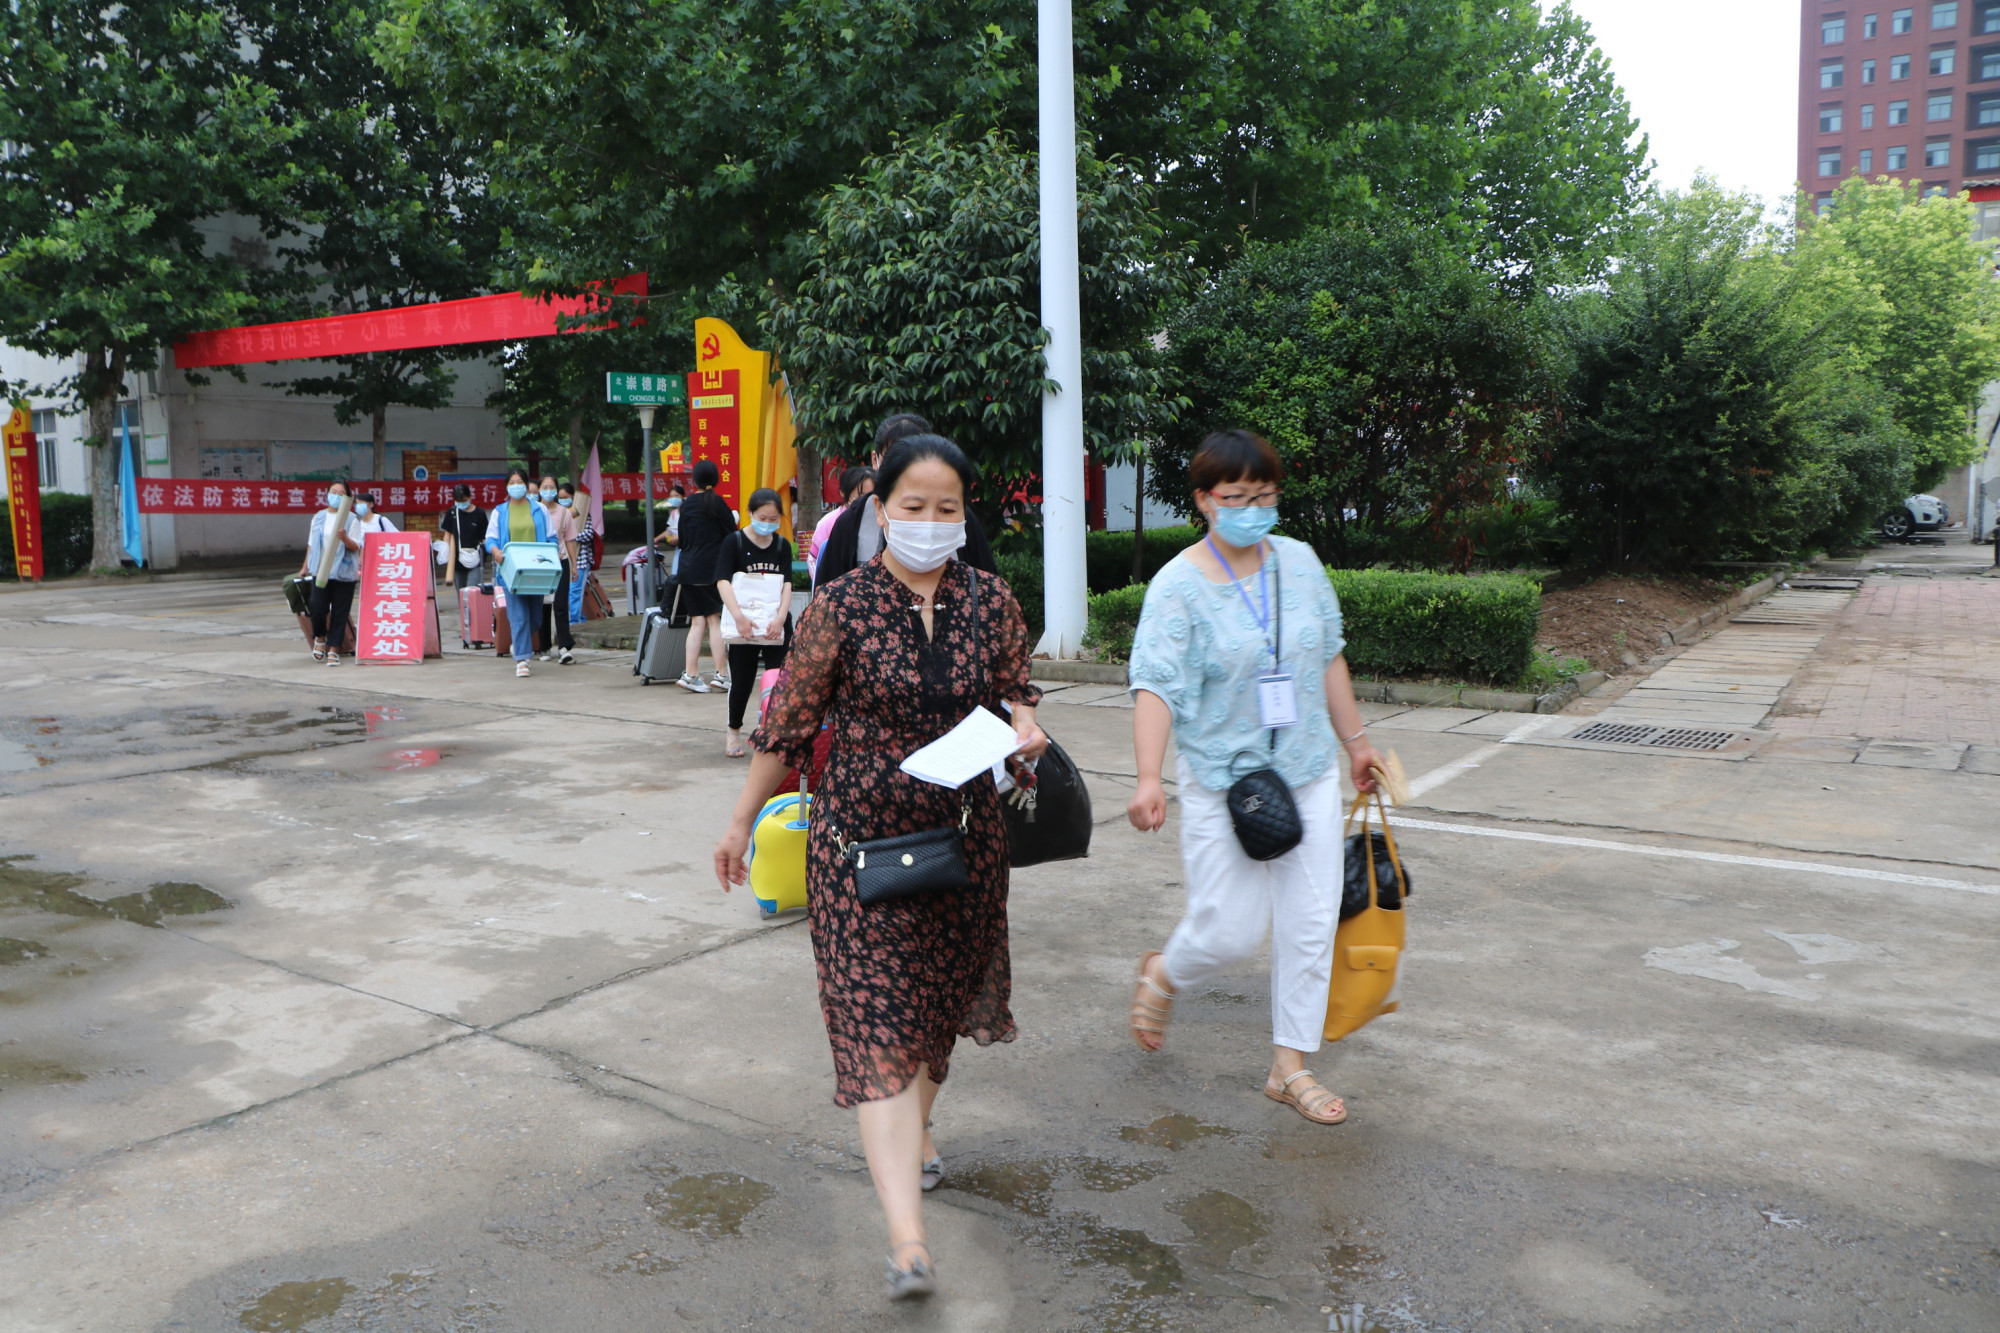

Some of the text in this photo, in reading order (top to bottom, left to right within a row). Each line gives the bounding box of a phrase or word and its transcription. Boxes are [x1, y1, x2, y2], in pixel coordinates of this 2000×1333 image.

[626, 375, 667, 392] 崇德路
[629, 394, 656, 402] CHONGDE
[720, 434, 731, 498] 知行合一
[371, 542, 416, 657] 机动车停放处
